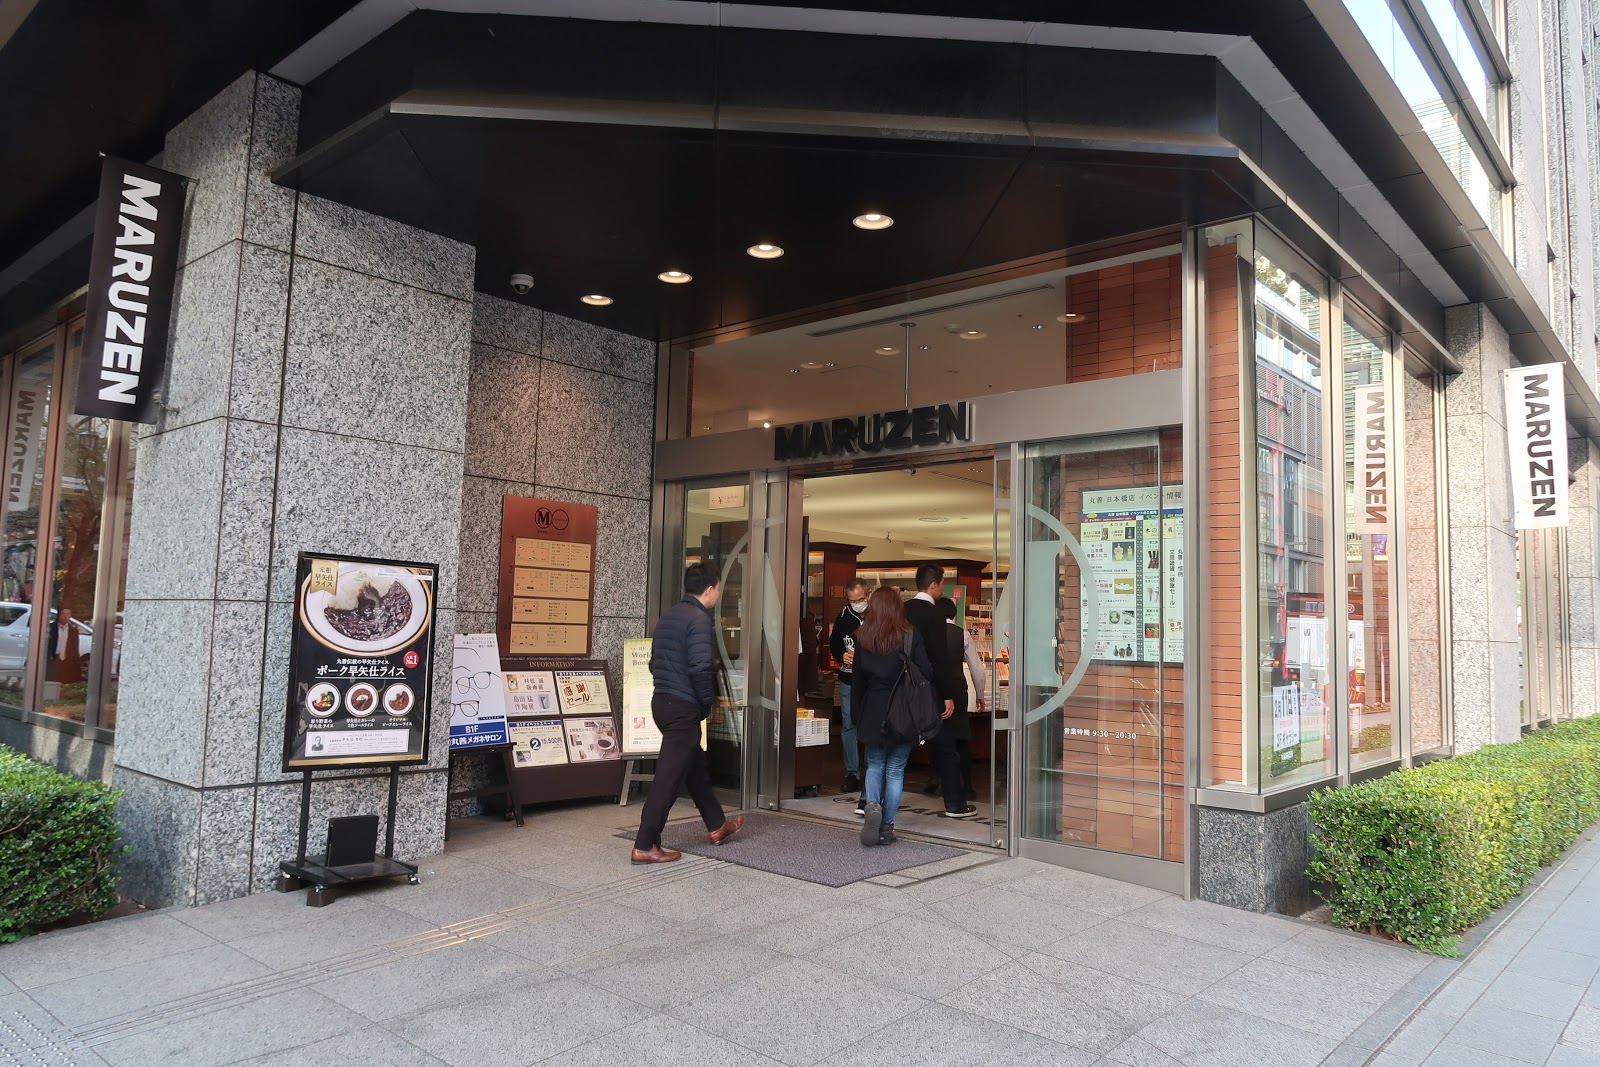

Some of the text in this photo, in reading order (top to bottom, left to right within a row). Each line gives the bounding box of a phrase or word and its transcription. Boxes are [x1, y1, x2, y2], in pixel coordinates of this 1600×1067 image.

[98, 173, 162, 405] MARUZEN
[774, 401, 970, 461] MARUZEN
[1523, 373, 1556, 518] MARUZEN
[1089, 491, 1182, 504] 丸善 日本橋店 イベン情報
[315, 573, 334, 581] 早矢仕
[317, 665, 405, 677] ポーク早矢仕ライス
[563, 682, 586, 697] 感謝
[566, 692, 590, 706] セール
[465, 725, 479, 733] B1F
[1063, 727, 1090, 737] 営業時間
[449, 734, 502, 746] 丸善メガネサロン
